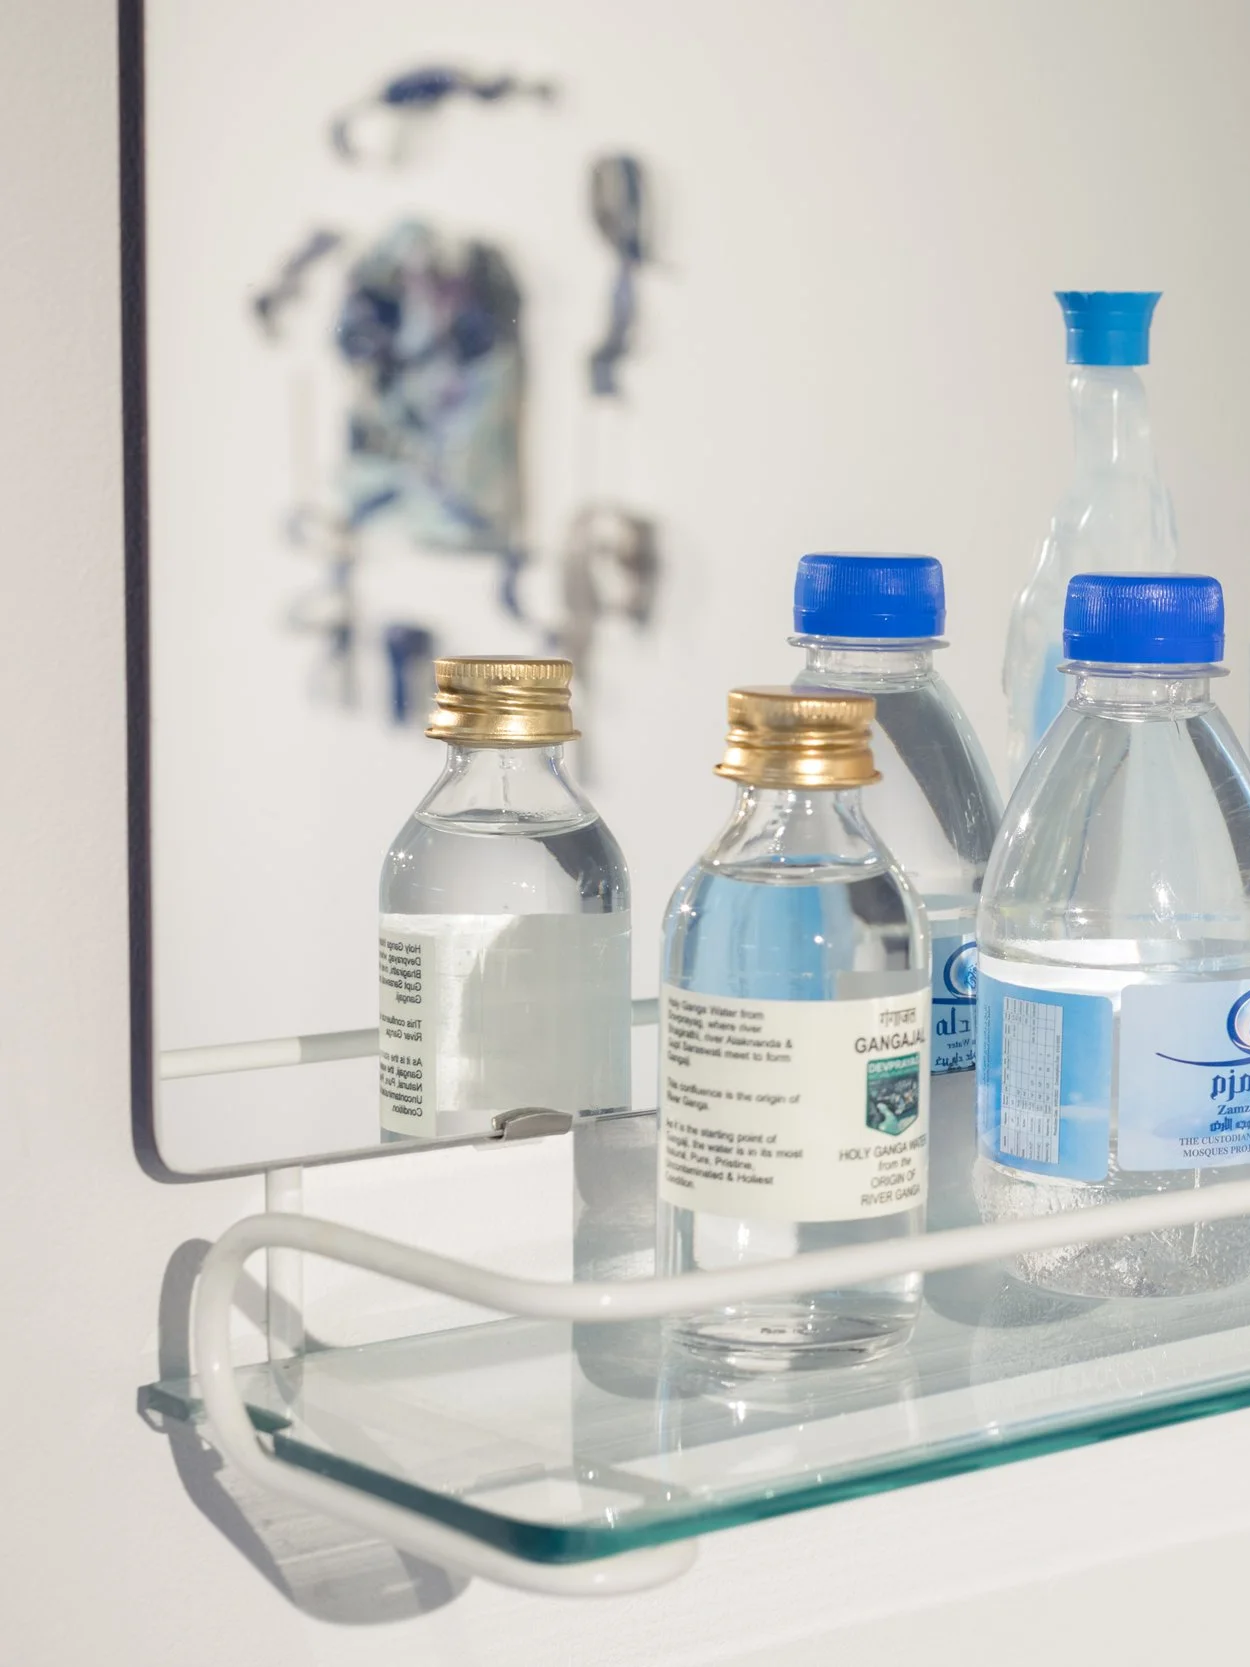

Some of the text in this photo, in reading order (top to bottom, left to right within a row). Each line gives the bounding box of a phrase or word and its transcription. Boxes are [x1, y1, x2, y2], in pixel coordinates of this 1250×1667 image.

[740, 1008, 764, 1020] from
[708, 1020, 736, 1032] where
[739, 1024, 762, 1033] river
[785, 1038, 793, 1049] &
[855, 1028, 925, 1054] GANGAJAL
[724, 1050, 750, 1061] meet
[753, 1052, 763, 1061] to
[766, 1051, 791, 1062] form
[725, 1091, 734, 1100] is
[736, 1090, 752, 1102] the
[755, 1093, 787, 1106] origin
[789, 1093, 801, 1104] of
[686, 1124, 698, 1135] the
[701, 1128, 734, 1143] starting
[737, 1133, 763, 1144] point
[766, 1134, 777, 1144] of
[692, 1139, 705, 1151] the
[708, 1143, 733, 1154] water
[736, 1147, 745, 1156] is
[748, 1148, 758, 1157] in
[760, 1148, 773, 1158] its
[775, 1149, 803, 1159] most
[1179, 1137, 1200, 1147] THE
[839, 1147, 871, 1162] HOLY
[873, 1141, 907, 1158] GANGA
[1183, 1147, 1229, 1158] MOSQUES
[878, 1159, 899, 1171] from
[727, 1171, 734, 1182] &
[737, 1172, 774, 1185] Holiest
[870, 1172, 905, 1189] ORIGIN
[860, 1190, 893, 1206] RIVER
